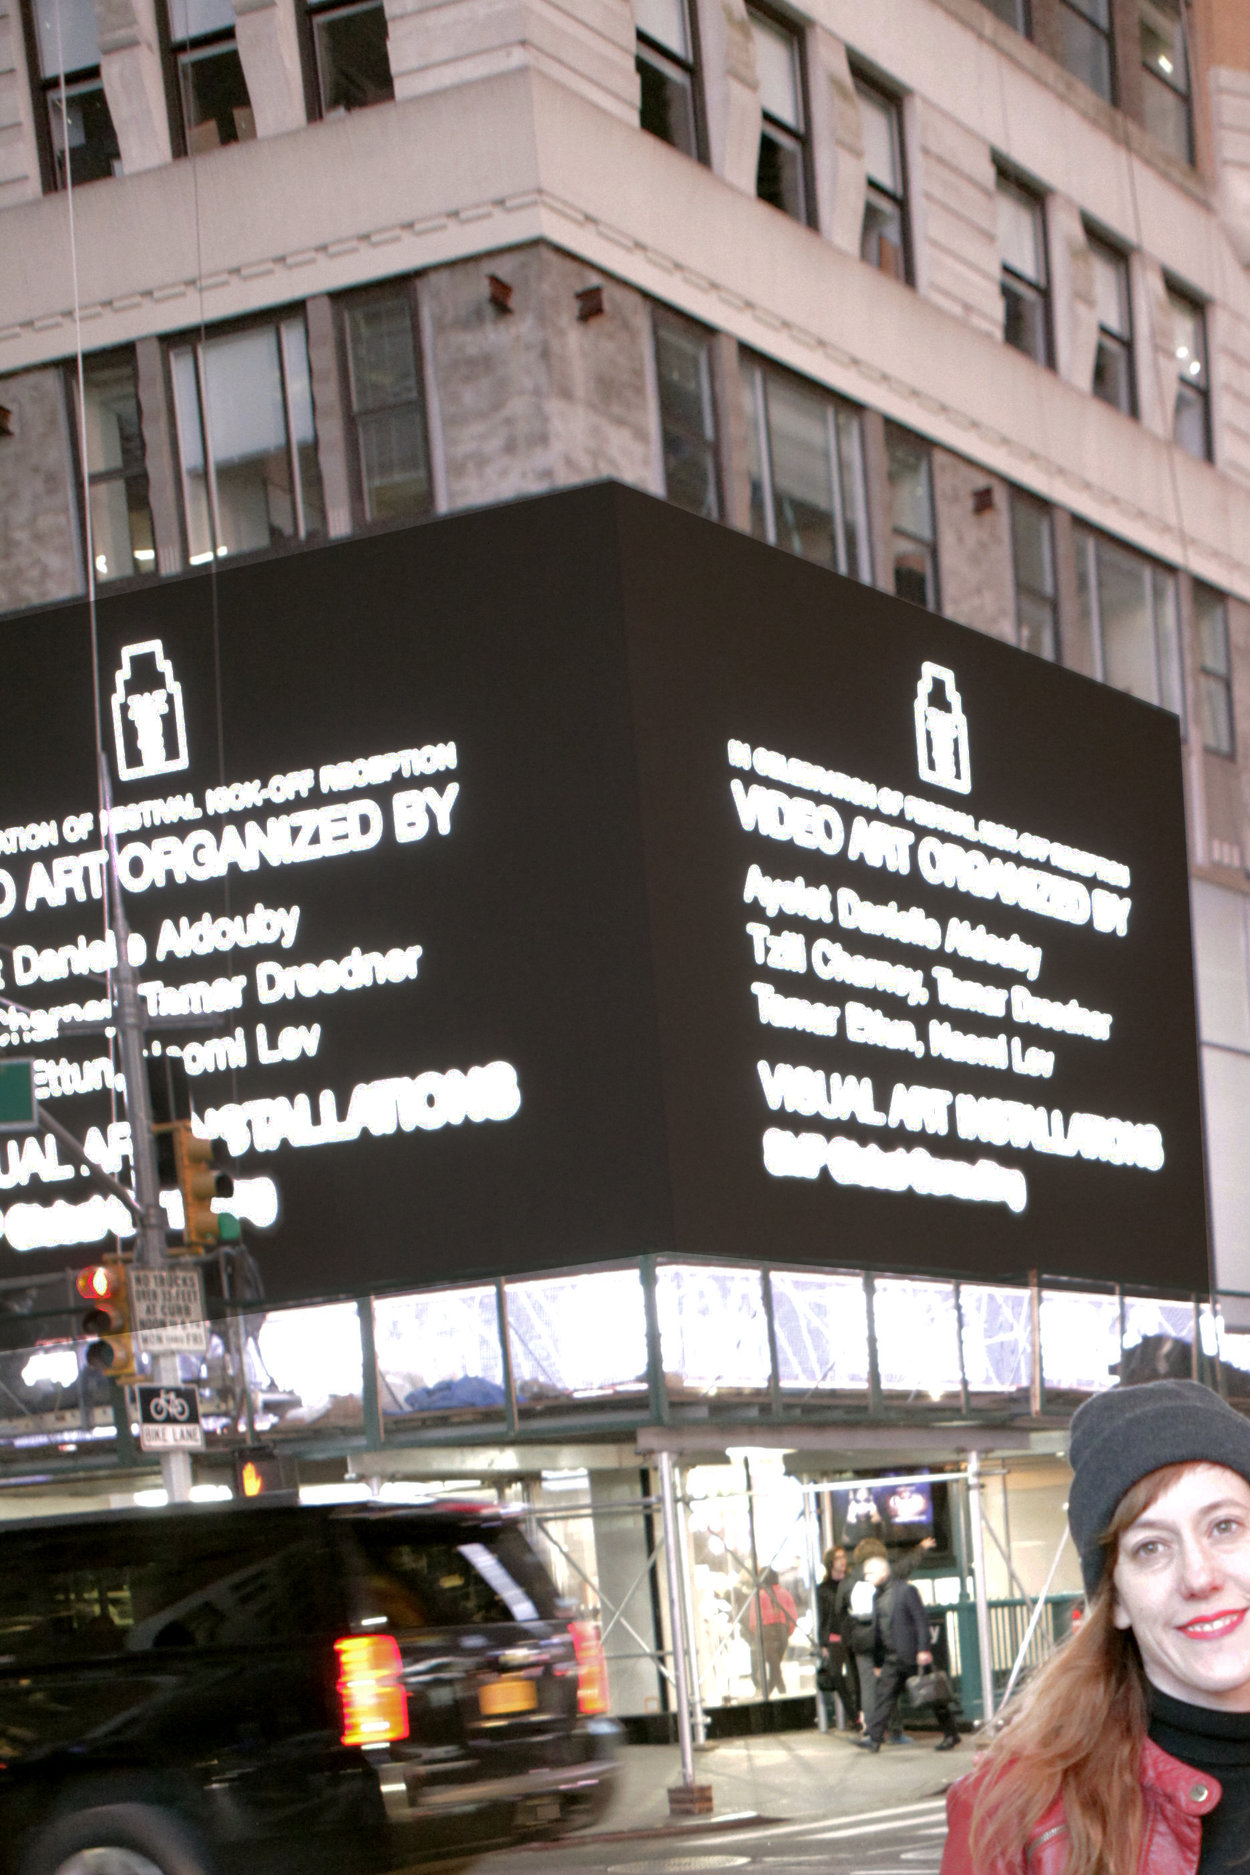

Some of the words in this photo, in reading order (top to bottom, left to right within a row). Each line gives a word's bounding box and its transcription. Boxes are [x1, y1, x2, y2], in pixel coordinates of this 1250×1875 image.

[25, 849, 109, 912] ART
[117, 798, 384, 893] ORGANIZED
[392, 782, 460, 843] BY
[730, 778, 845, 856] VIDEO
[847, 815, 915, 876] ART
[917, 836, 1092, 926] ORGANIZED
[1091, 888, 1132, 938] BY
[155, 902, 301, 962] Aldouby
[255, 1022, 322, 1065] Lev
[756, 1059, 888, 1127] VISUAL
[887, 1082, 954, 1136] ART
[134, 1274, 150, 1287] NO
[153, 1274, 196, 1288] TRUCKS
[160, 1303, 192, 1317] CURB
[144, 1427, 167, 1442] BIKE
[171, 1427, 199, 1442] LANE
